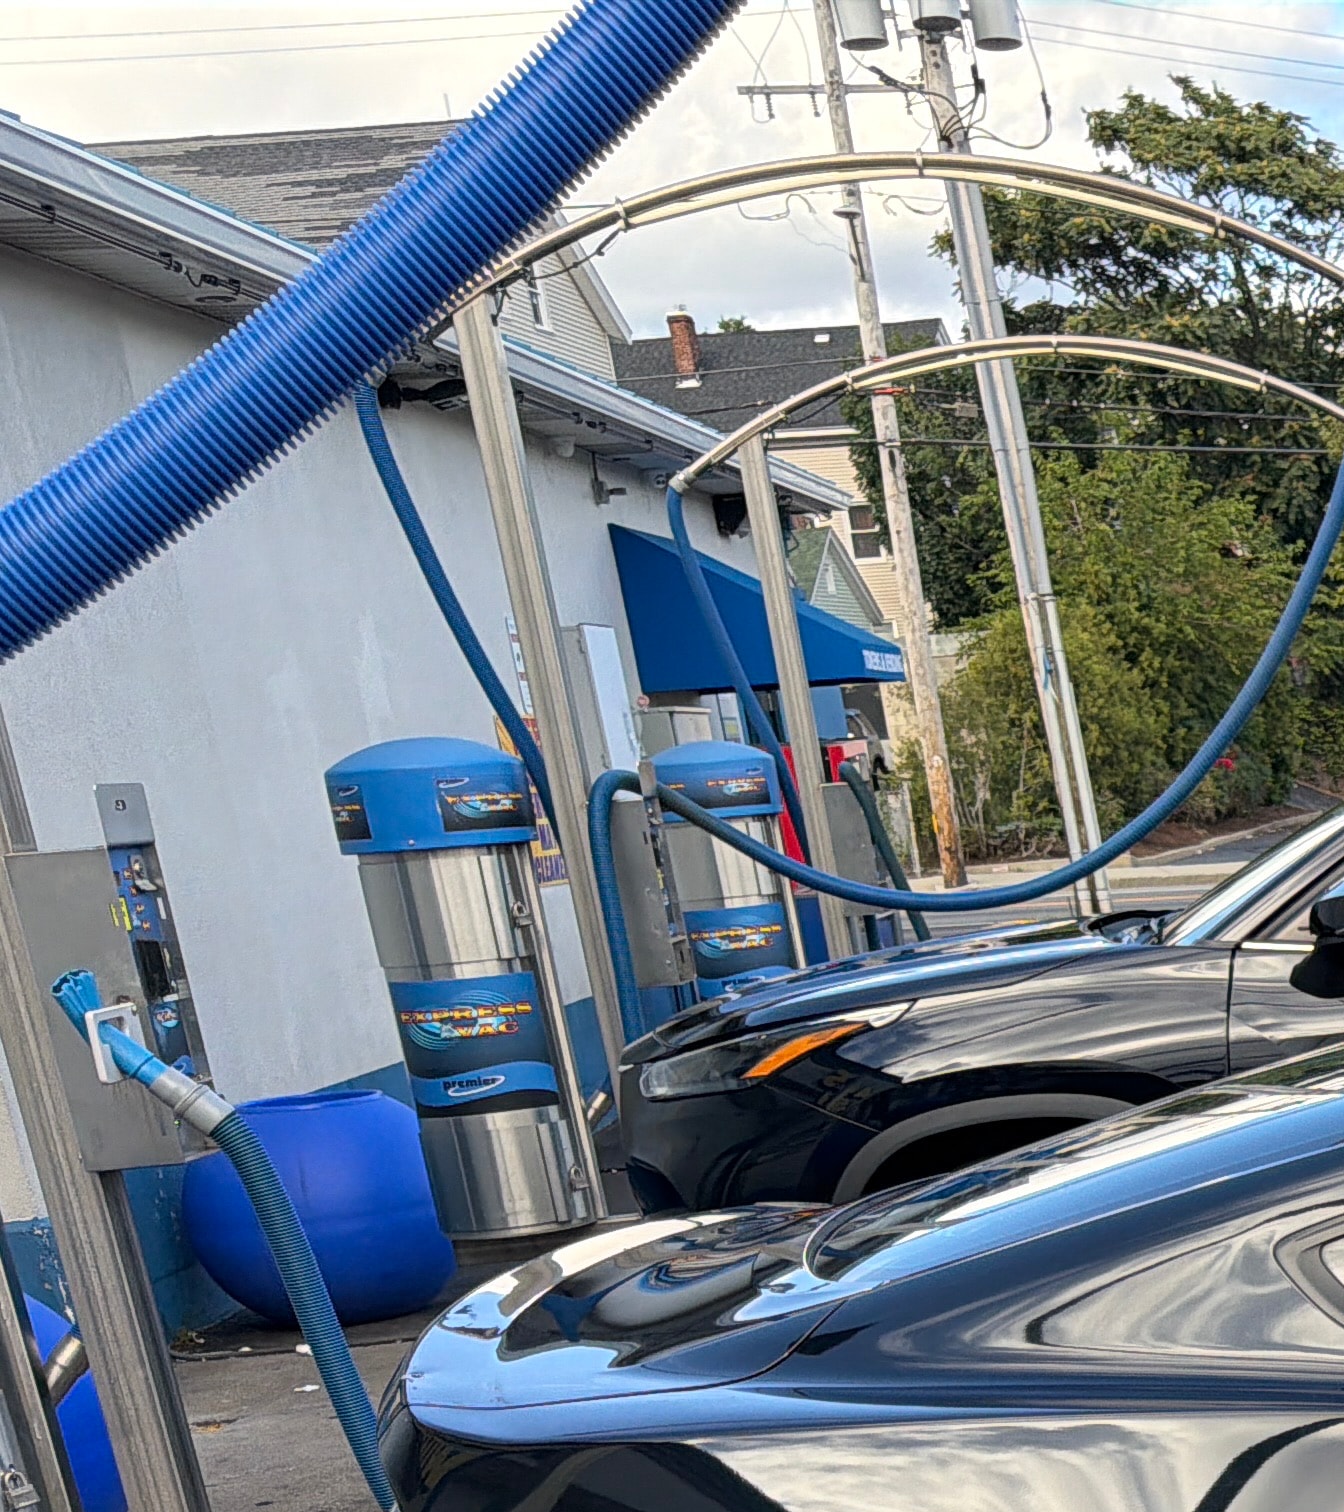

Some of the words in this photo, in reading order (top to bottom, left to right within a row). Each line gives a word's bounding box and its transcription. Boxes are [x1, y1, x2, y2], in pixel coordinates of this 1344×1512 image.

[400, 1001, 533, 1025] EXPRESS
[455, 1021, 519, 1039] VAC
[443, 1076, 500, 1092] premier
